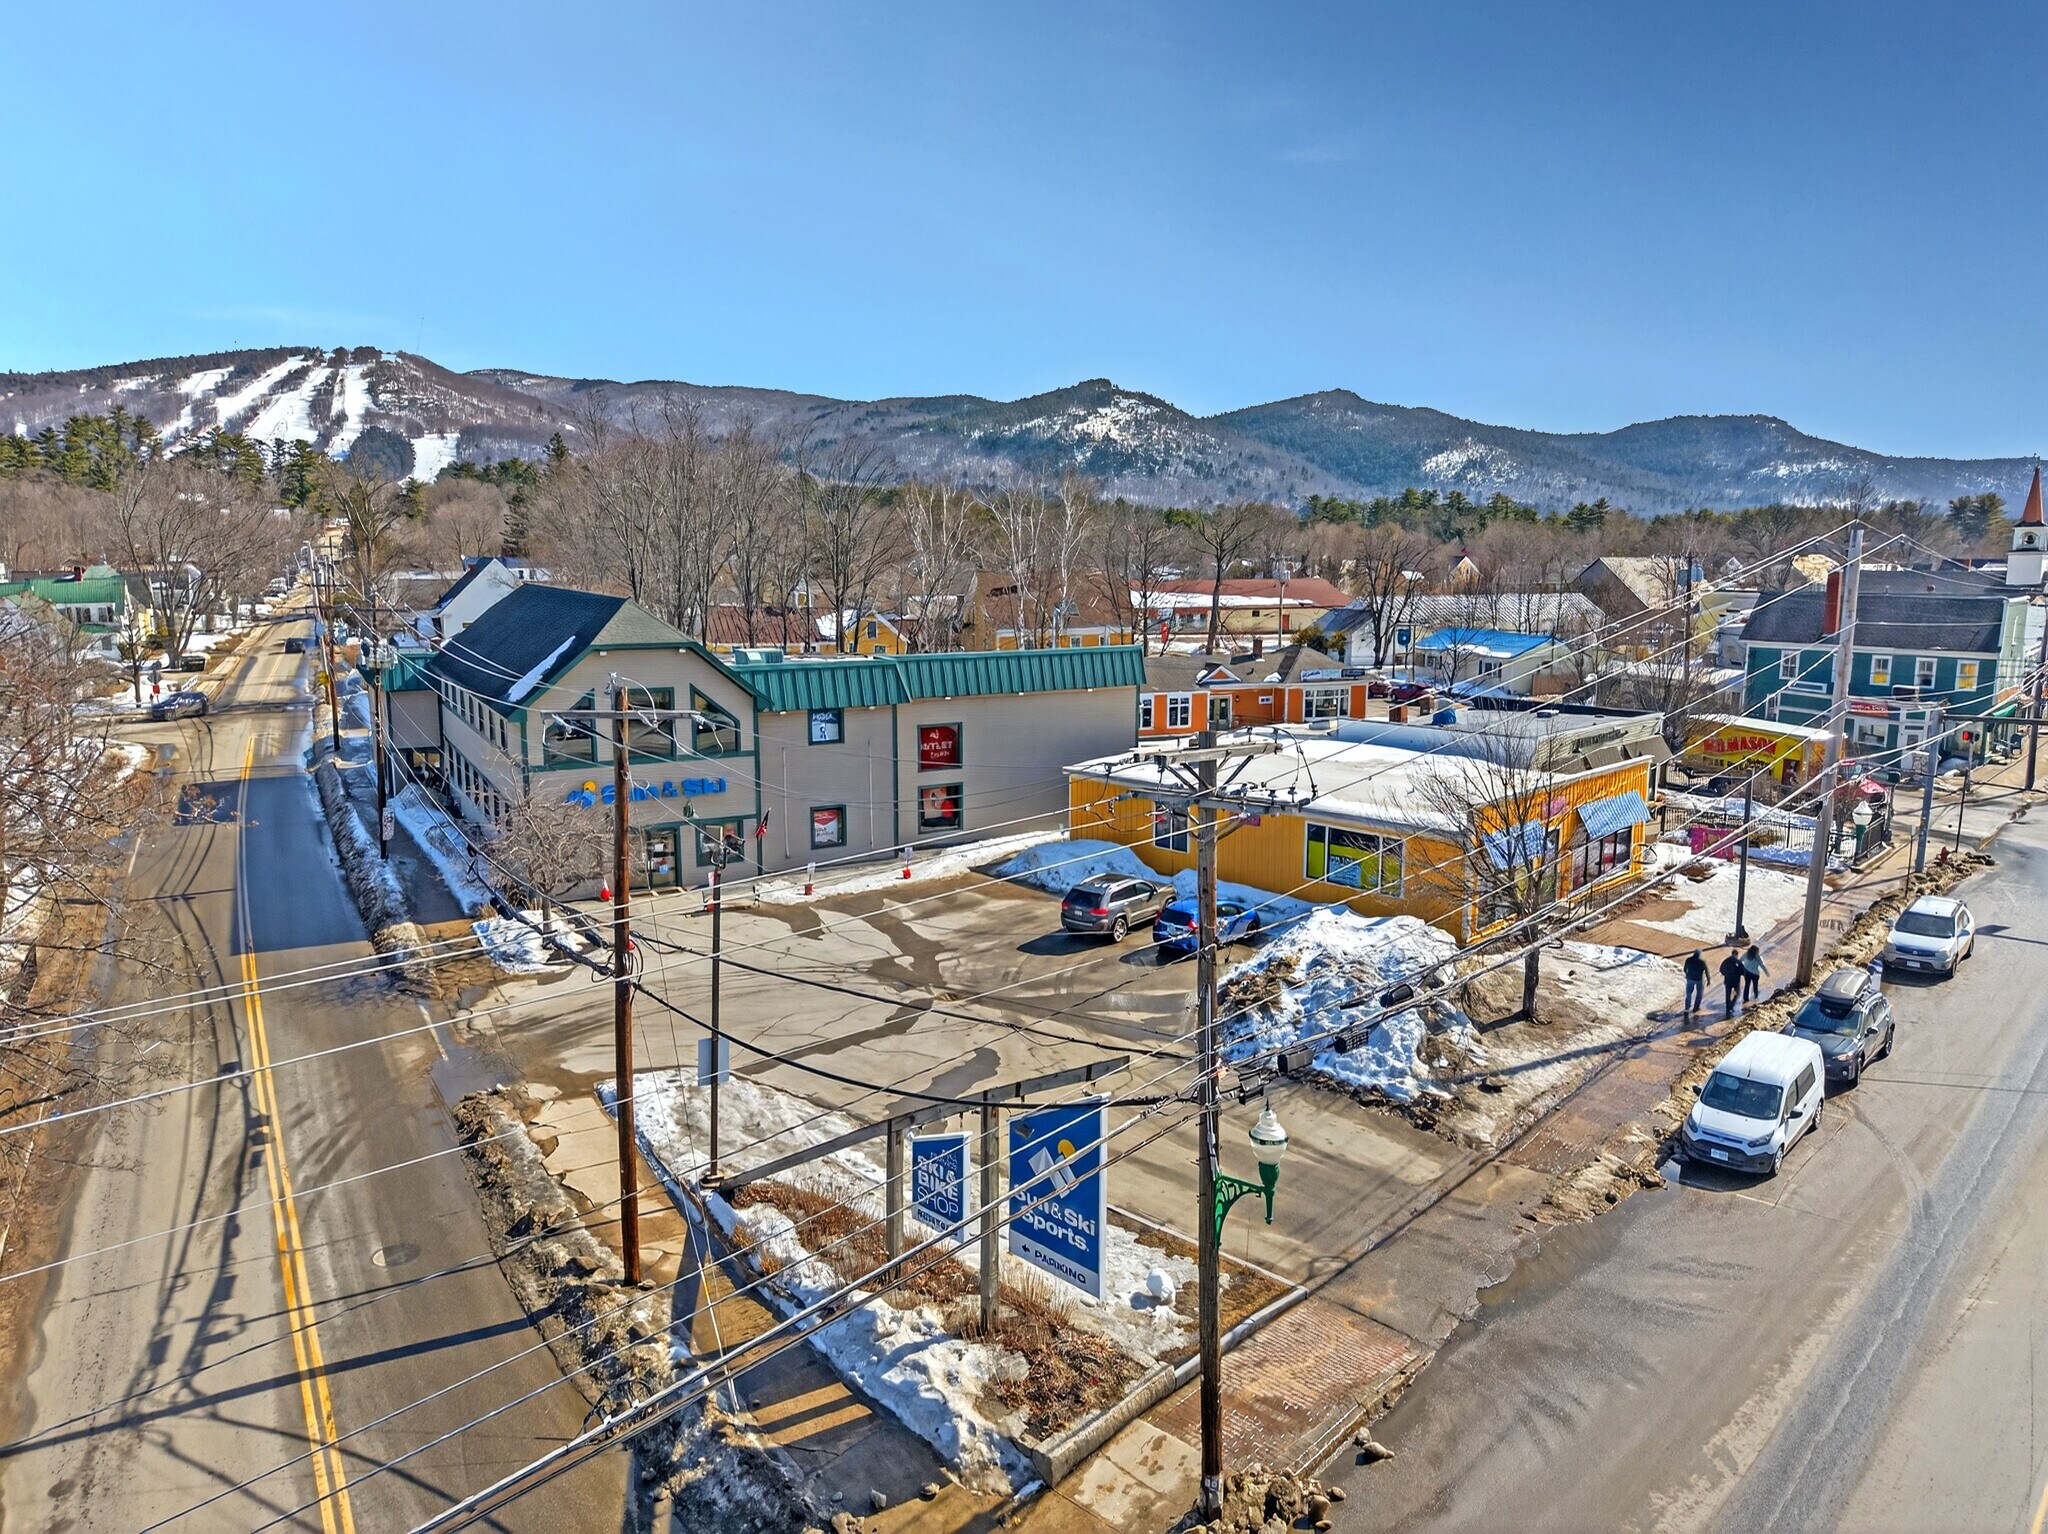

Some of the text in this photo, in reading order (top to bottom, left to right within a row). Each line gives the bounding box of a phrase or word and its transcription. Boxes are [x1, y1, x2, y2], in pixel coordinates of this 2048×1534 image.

[662, 780, 678, 798] &
[918, 1155, 944, 1180] SKI
[917, 1186, 959, 1217] SHOP
[918, 1170, 958, 1202] BIKE
[1013, 1184, 1096, 1237] Sun & Ski
[1034, 1249, 1087, 1285] PARKING
